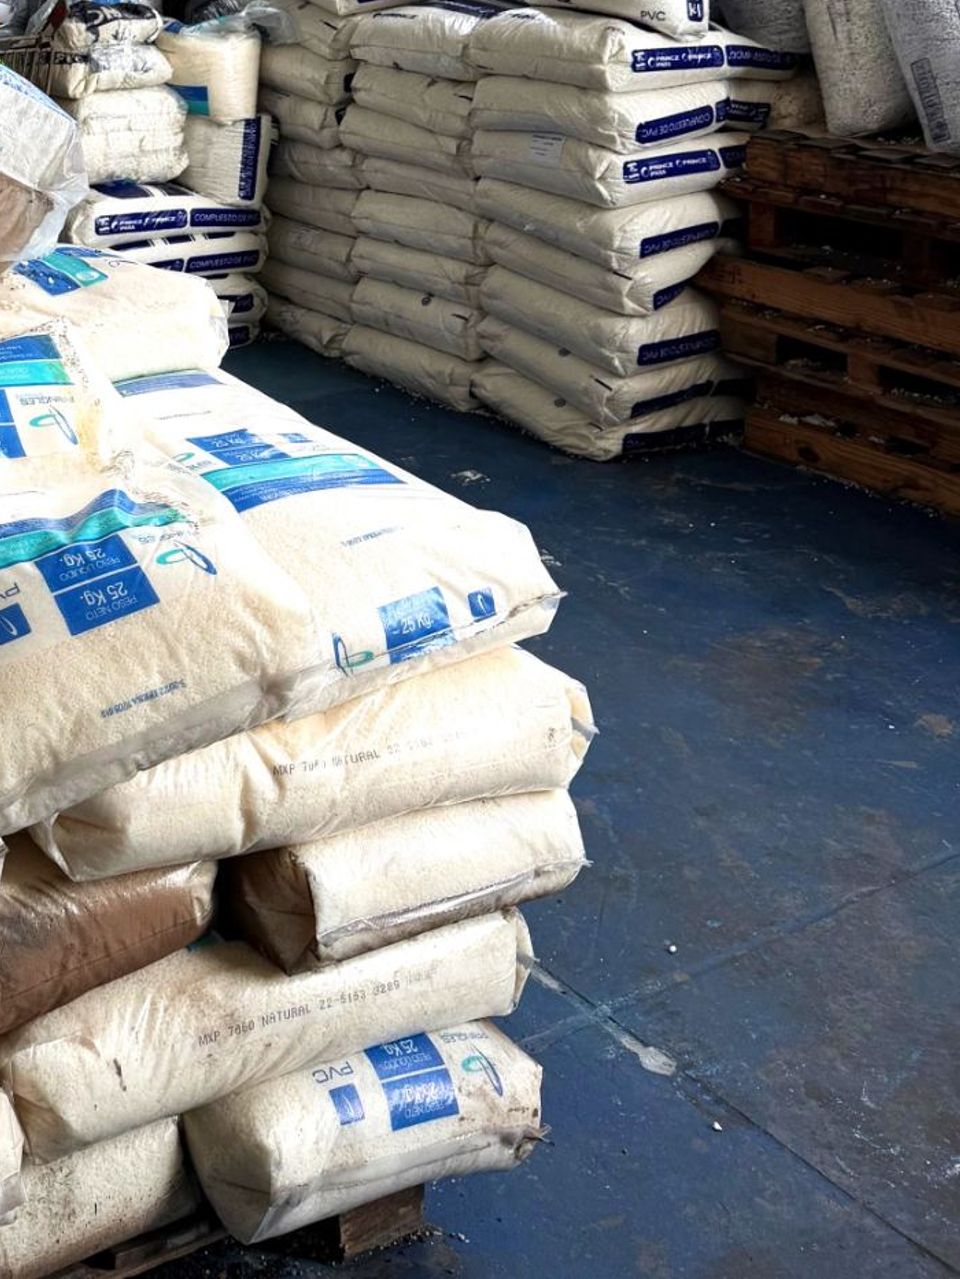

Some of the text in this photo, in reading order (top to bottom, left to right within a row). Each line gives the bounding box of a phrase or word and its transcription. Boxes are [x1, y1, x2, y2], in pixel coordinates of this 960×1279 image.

[640, 10, 666, 21] PVC
[642, 126, 658, 138] PVC
[58, 546, 107, 568] 25 Kg.
[78, 580, 129, 608] 25 Kg.
[84, 597, 139, 622] PESO NETO
[400, 618, 415, 634] 25
[197, 1029, 222, 1049] MXP
[261, 1003, 312, 1027] NATURAL
[400, 1038, 419, 1054] 25
[311, 1060, 355, 1085] PVC
